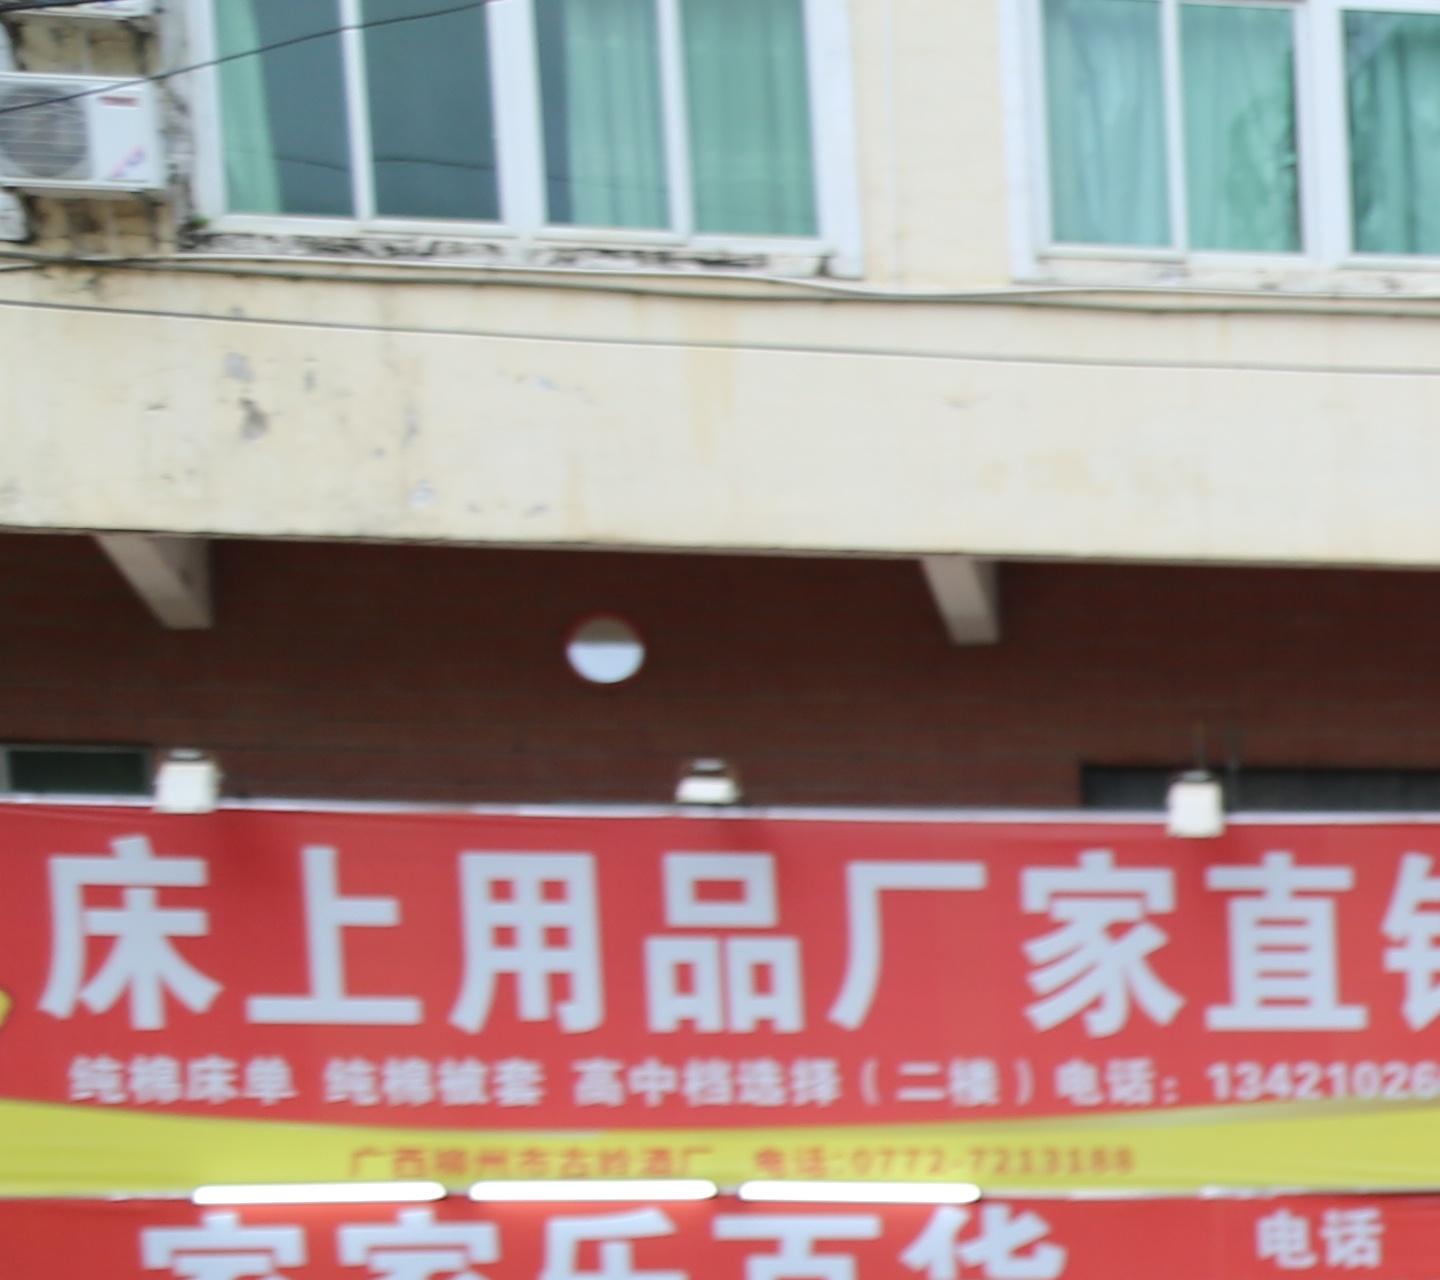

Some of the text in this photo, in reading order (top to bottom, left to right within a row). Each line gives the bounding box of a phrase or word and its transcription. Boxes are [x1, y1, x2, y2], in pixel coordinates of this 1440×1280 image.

[68, 1054, 298, 1104] 纯棉床单
[322, 1056, 546, 1107] 纯棉被套
[1256, 1210, 1384, 1269] 电话
